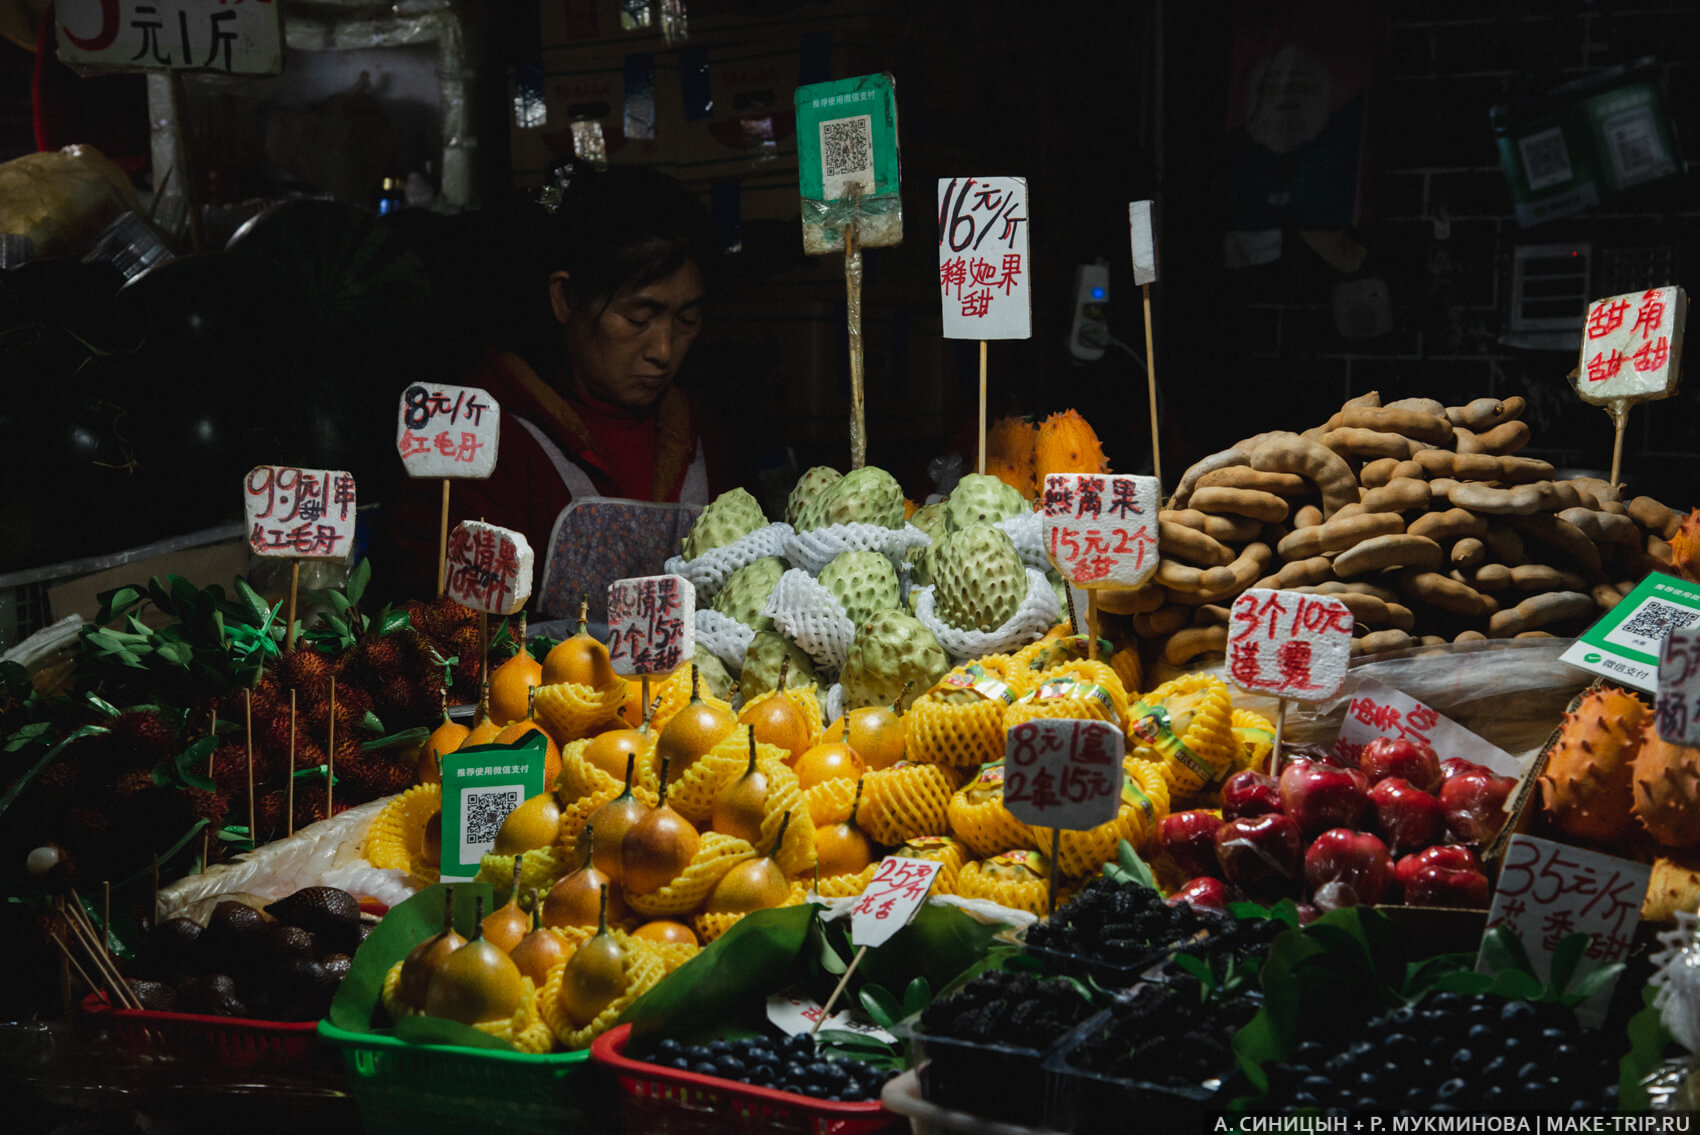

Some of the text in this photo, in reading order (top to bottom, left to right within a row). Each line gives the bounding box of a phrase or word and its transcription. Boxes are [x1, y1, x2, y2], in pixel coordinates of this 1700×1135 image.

[63, 0, 238, 72] 元1斤
[939, 178, 1027, 252] 16元/斤
[961, 287, 994, 318] 甜
[404, 385, 490, 430] 8元/斤
[399, 429, 484, 462] 红毛丹
[251, 522, 345, 554] 红毛丹
[1050, 525, 1157, 570] 15元2个
[1229, 592, 1353, 643] 3个10元
[1602, 658, 1650, 680] 微信支付
[456, 765, 530, 778] 推荐使用微信支付
